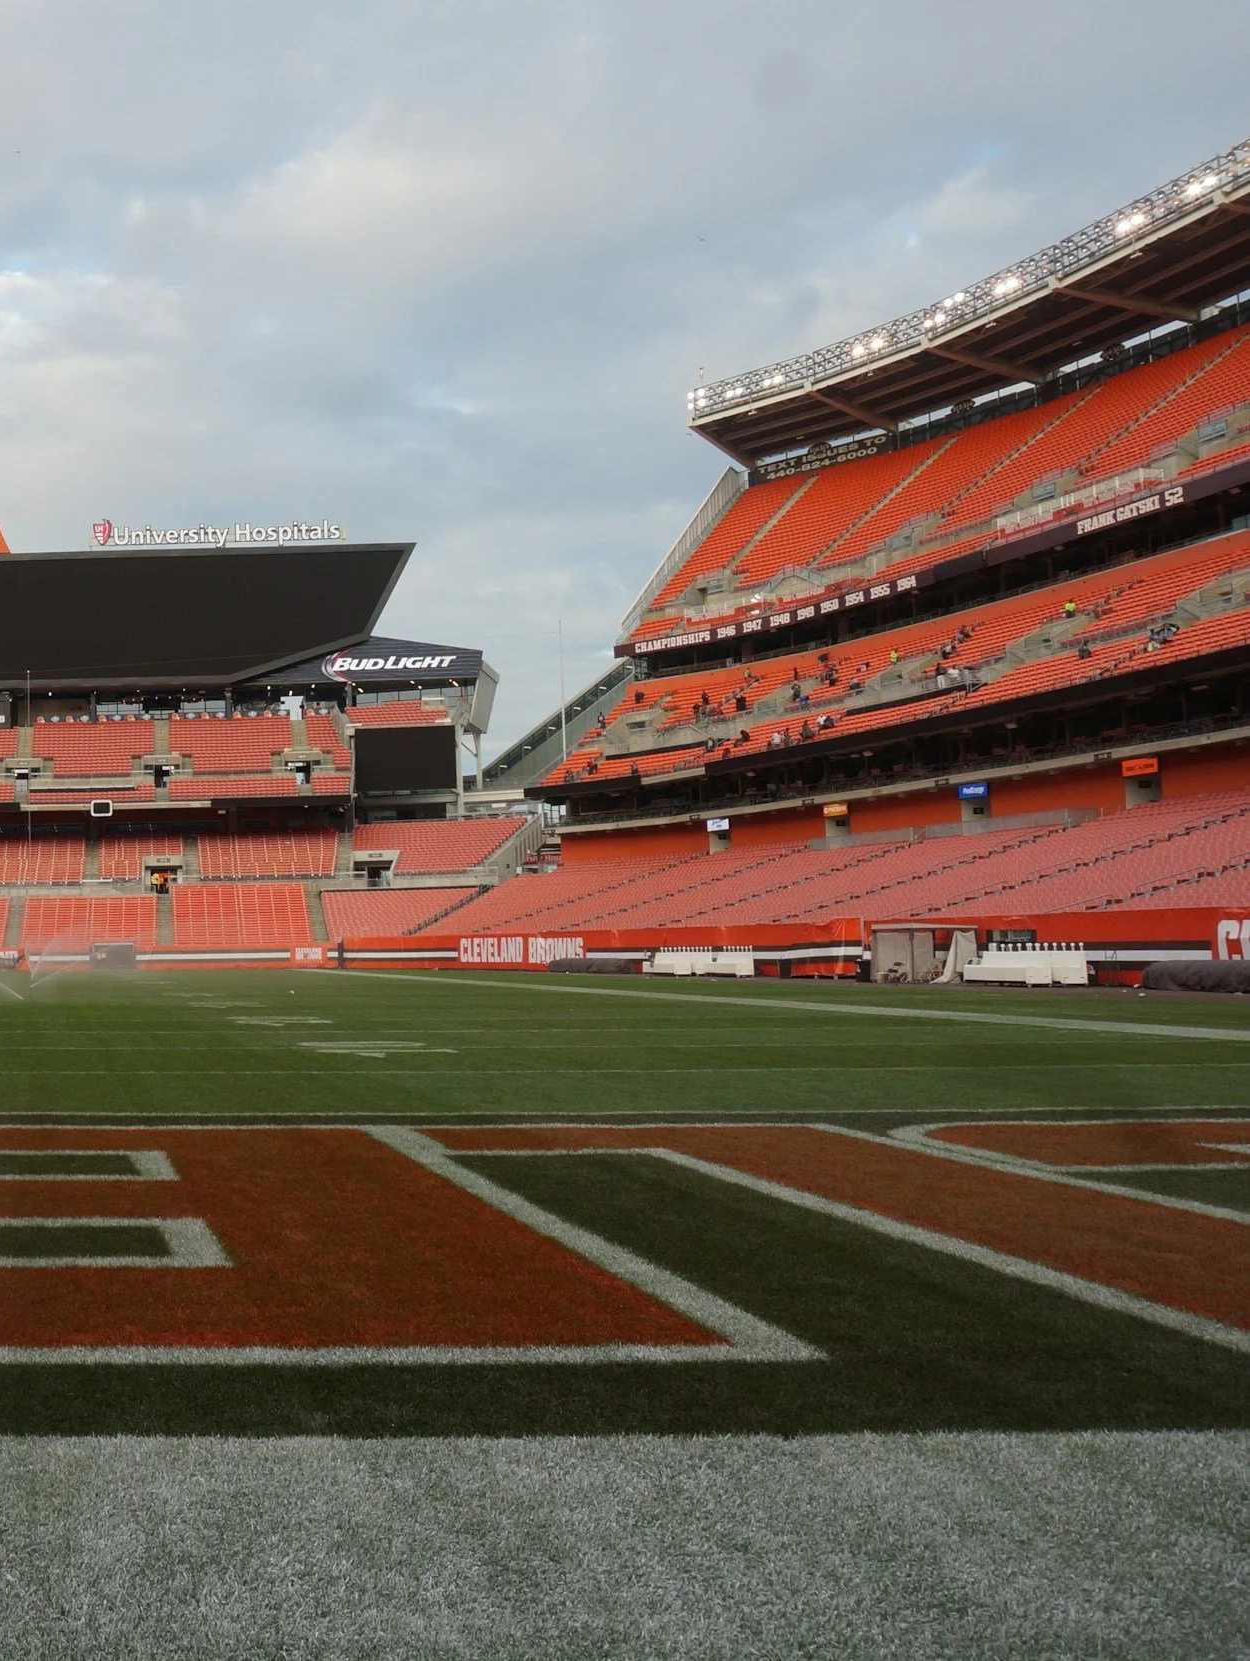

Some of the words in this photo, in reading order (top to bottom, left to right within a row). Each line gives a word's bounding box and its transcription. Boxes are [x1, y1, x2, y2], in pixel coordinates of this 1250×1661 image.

[758, 459, 797, 474] TEXT
[802, 443, 859, 463] ISSUES
[865, 436, 887, 447] TO
[766, 447, 878, 480] 440-824-6000
[1077, 510, 1116, 535] FRANK
[1116, 494, 1160, 521] GATSKI
[1164, 487, 1184, 507] 52
[113, 524, 229, 548] University
[235, 520, 340, 546] Hospitals
[635, 631, 710, 654] CHAMPIONSHIPS
[717, 625, 736, 639] 1946
[743, 619, 762, 633] 1947
[770, 612, 790, 627] 1948
[797, 606, 815, 620] 1949
[820, 598, 839, 613] 1950
[845, 591, 864, 606] 1954
[870, 583, 890, 599] 1955
[897, 575, 916, 591] 1964
[459, 937, 524, 963] CLEVELAND
[528, 937, 584, 964] BROWNS
